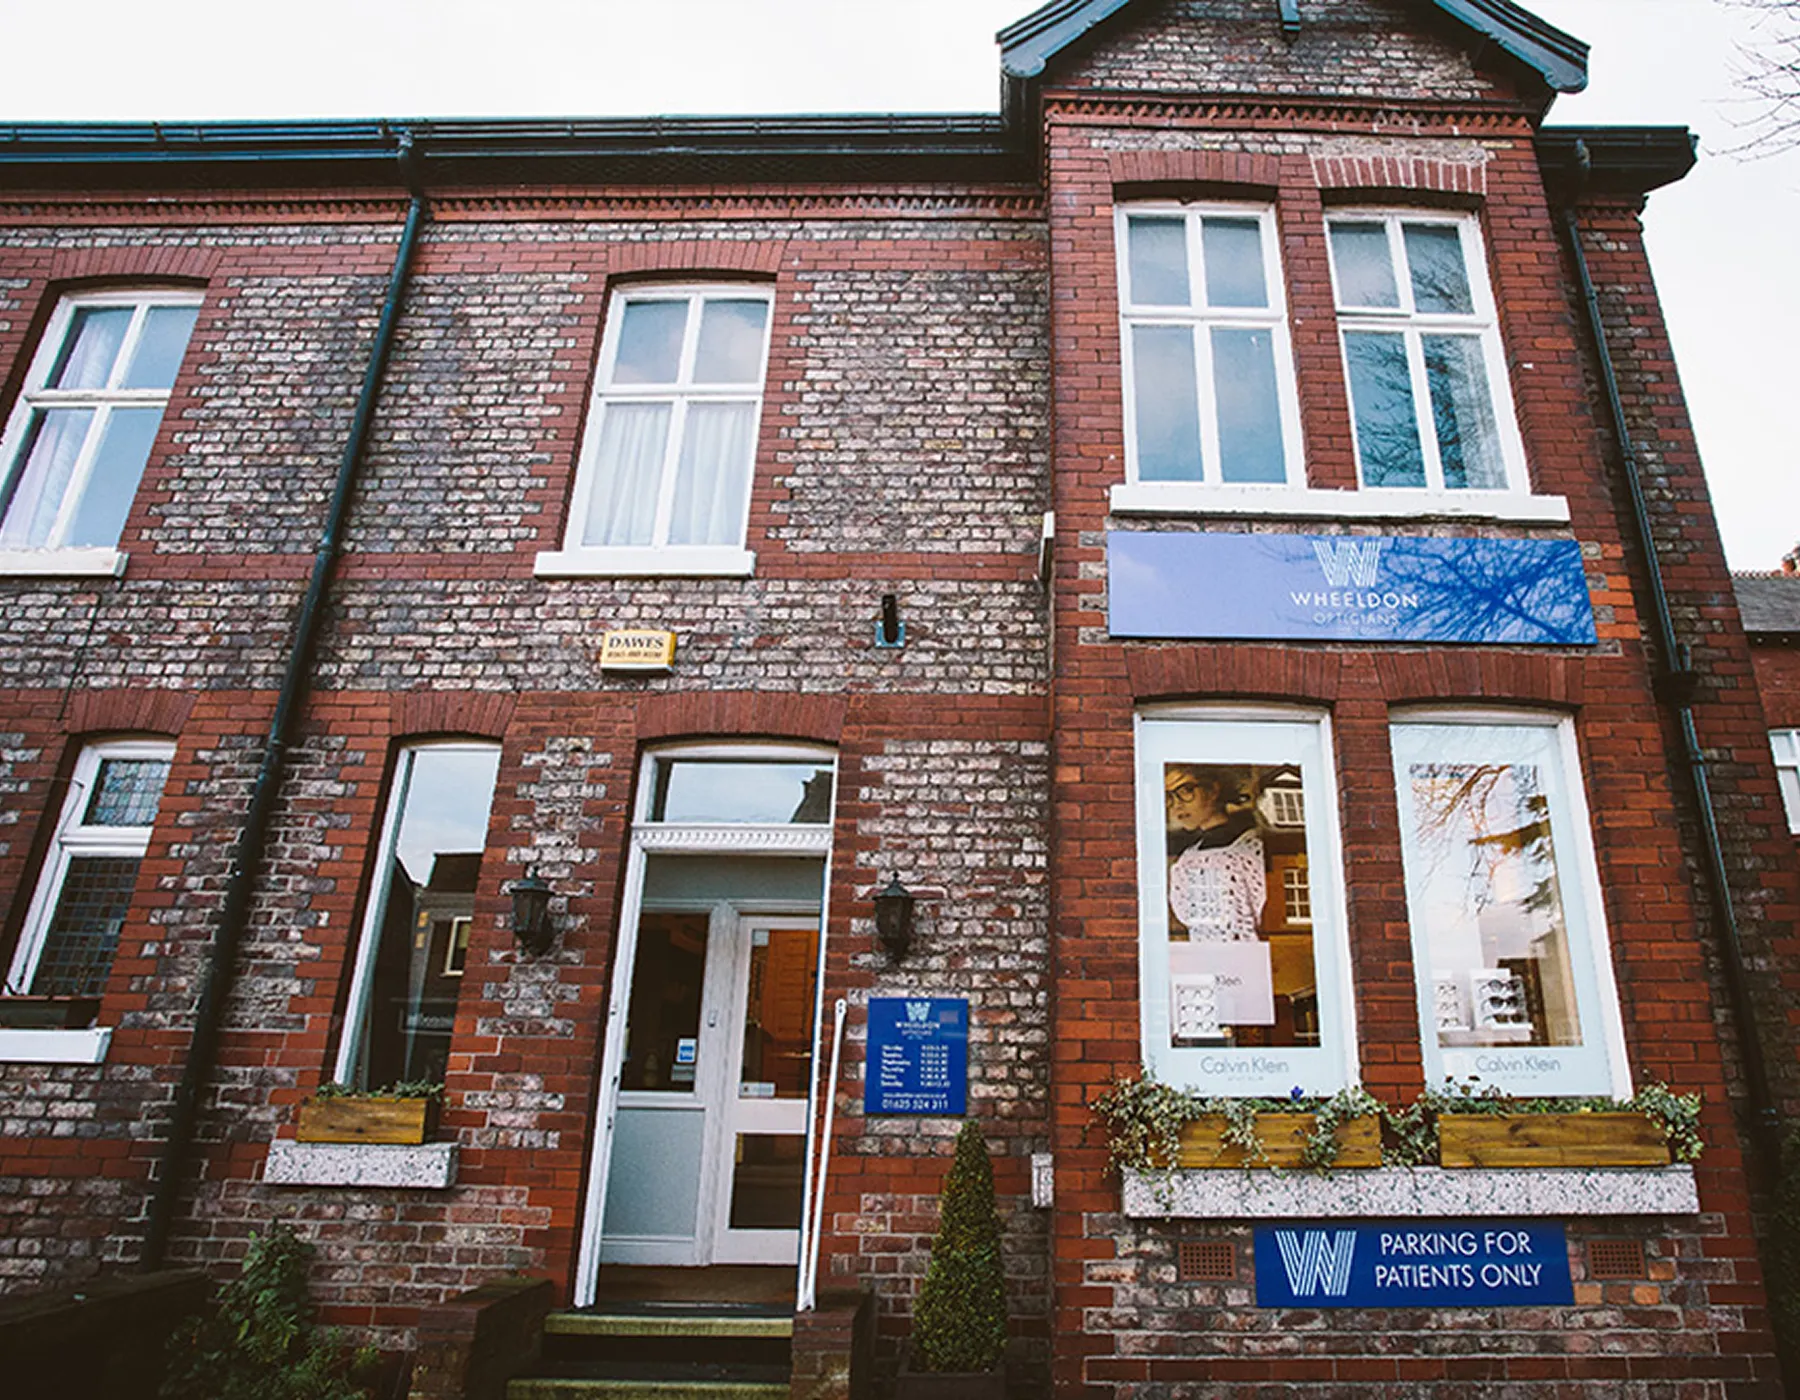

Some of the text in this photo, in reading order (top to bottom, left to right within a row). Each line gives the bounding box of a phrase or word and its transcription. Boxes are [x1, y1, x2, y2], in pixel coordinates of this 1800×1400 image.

[1290, 591, 1418, 609] WHEELDON
[608, 636, 664, 649] DAWES
[1200, 1055, 1290, 1074] Calvin Klein
[1475, 1054, 1561, 1073] Calvin Klein
[1380, 1231, 1533, 1256] PARKING FOR
[1375, 1263, 1543, 1288] PATIENTS ONLY
